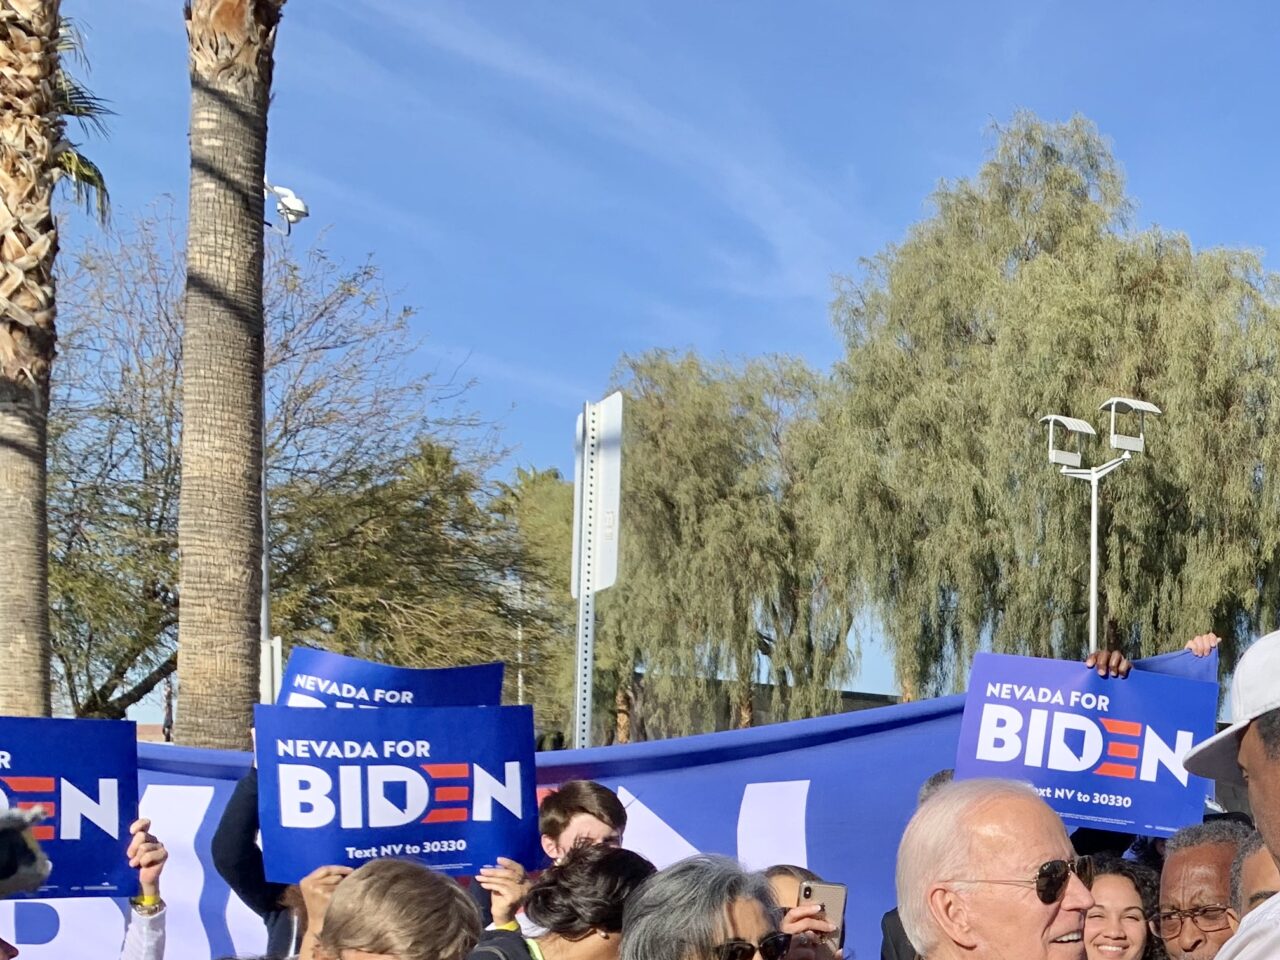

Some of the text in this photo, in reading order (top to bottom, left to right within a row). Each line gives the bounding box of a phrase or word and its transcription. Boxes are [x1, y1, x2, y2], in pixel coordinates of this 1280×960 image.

[294, 674, 369, 701] NEVADA
[373, 689, 413, 704] FOR
[986, 682, 1110, 712] NEVADA FOR
[277, 739, 430, 759] NEVADA FOR
[976, 703, 1194, 788] BIDEN
[278, 761, 523, 829] BIDEN
[1055, 788, 1075, 800] NV
[1077, 791, 1090, 803] to
[1092, 793, 1132, 808] 30330
[345, 840, 466, 860] Text NV to 30330
